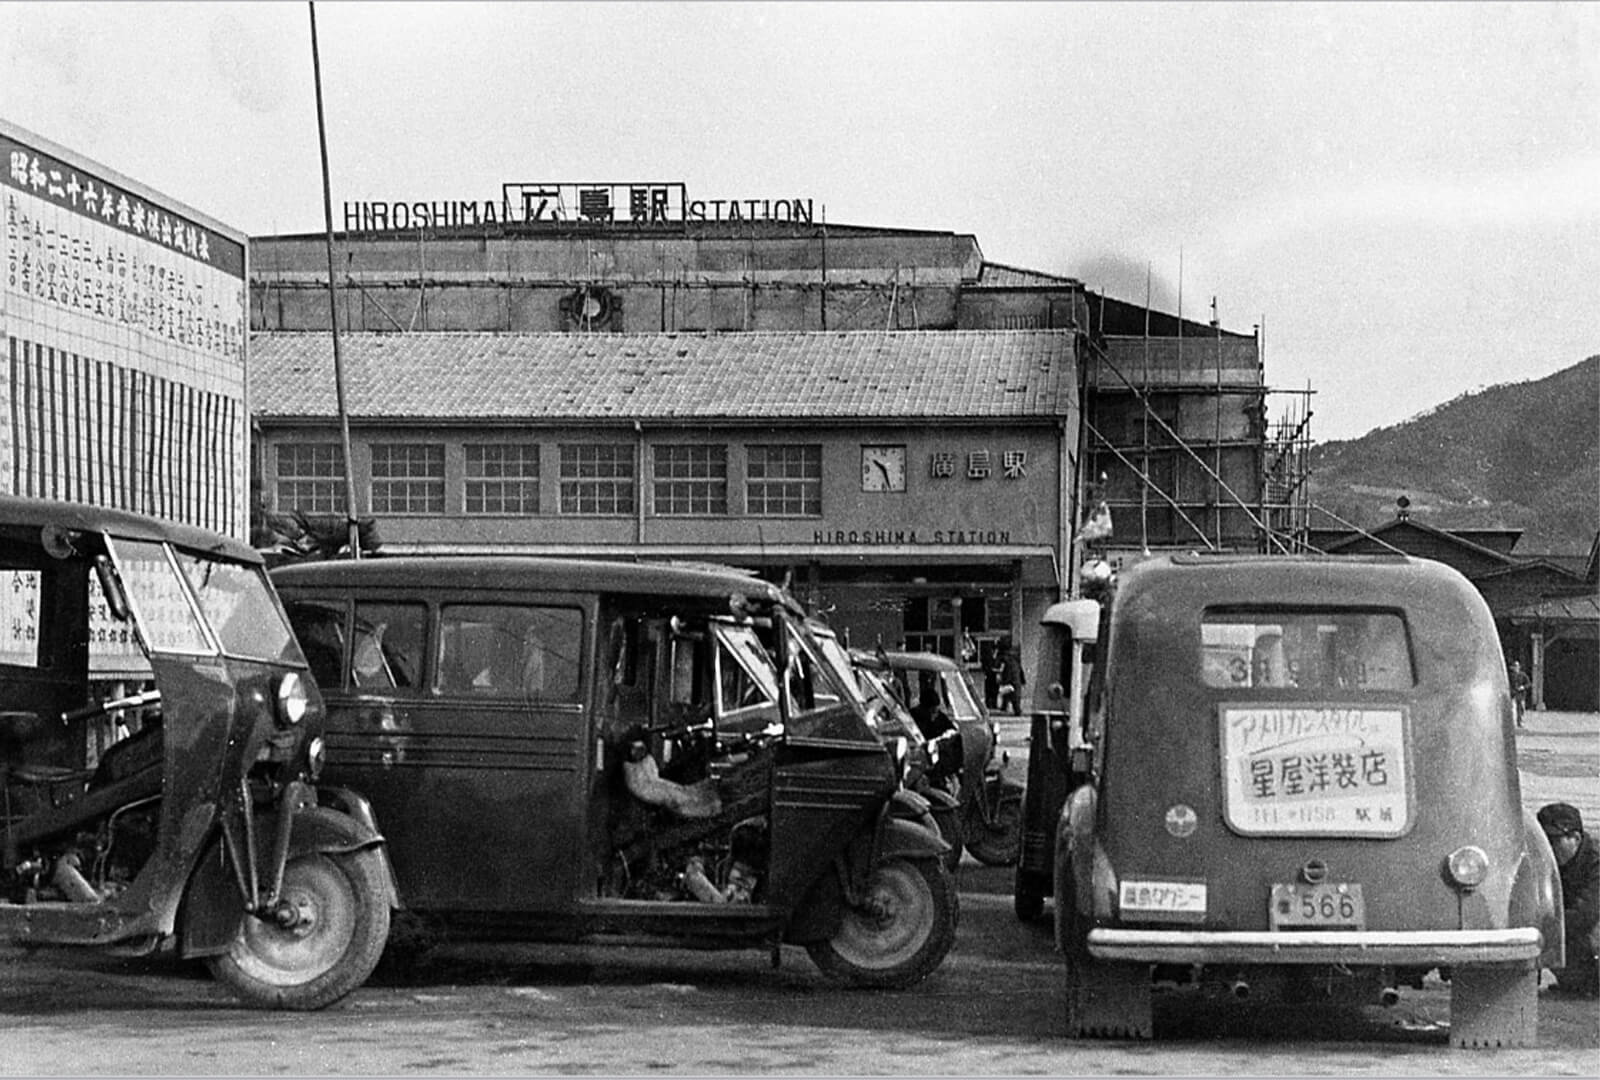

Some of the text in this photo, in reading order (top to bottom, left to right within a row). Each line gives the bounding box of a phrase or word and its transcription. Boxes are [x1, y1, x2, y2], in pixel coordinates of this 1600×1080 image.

[344, 188, 814, 231] HIROSHIMA 広島駅 STATION
[814, 531, 1010, 544] HIROSHIMA STATION
[1302, 894, 1354, 918] 566
